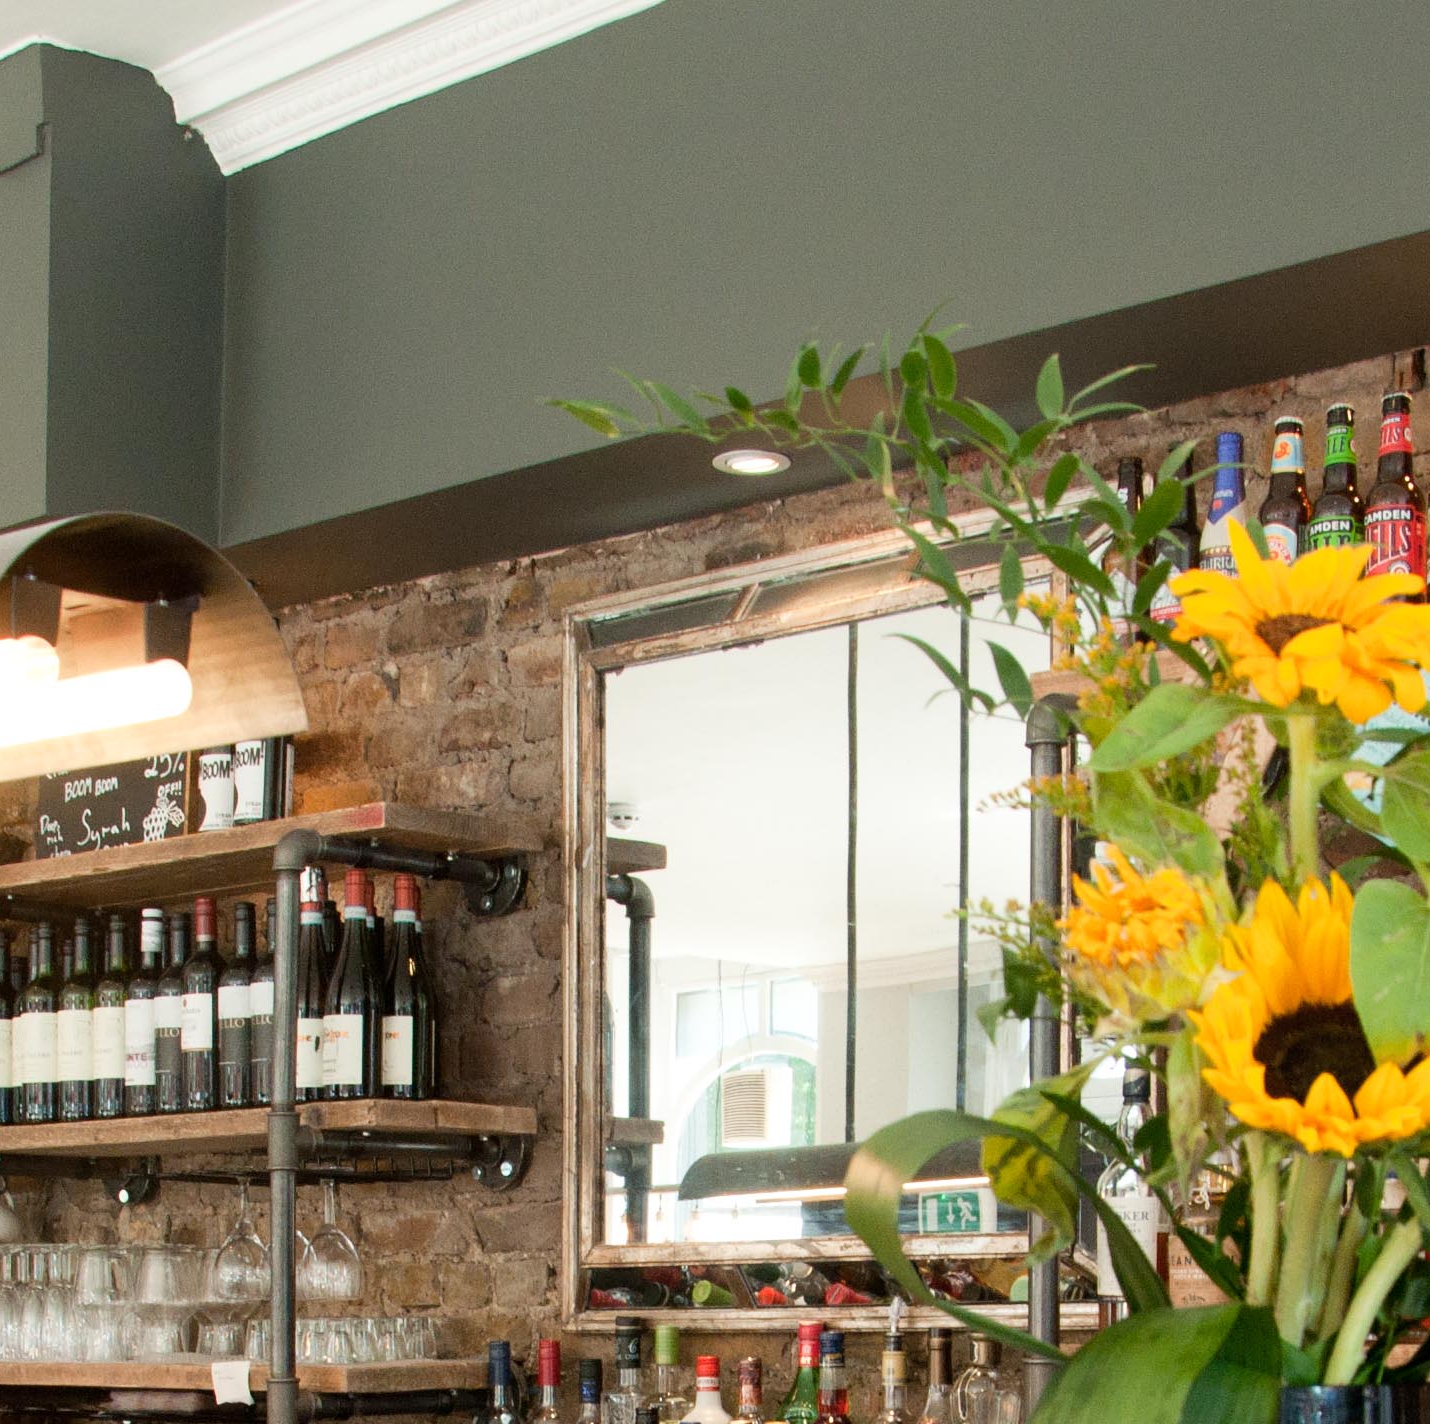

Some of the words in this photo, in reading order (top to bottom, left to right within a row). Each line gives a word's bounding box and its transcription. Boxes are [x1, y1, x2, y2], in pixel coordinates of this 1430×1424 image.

[65, 776, 93, 803] BOOM
[95, 776, 119, 797] BOOM
[77, 808, 131, 850] Syrah
